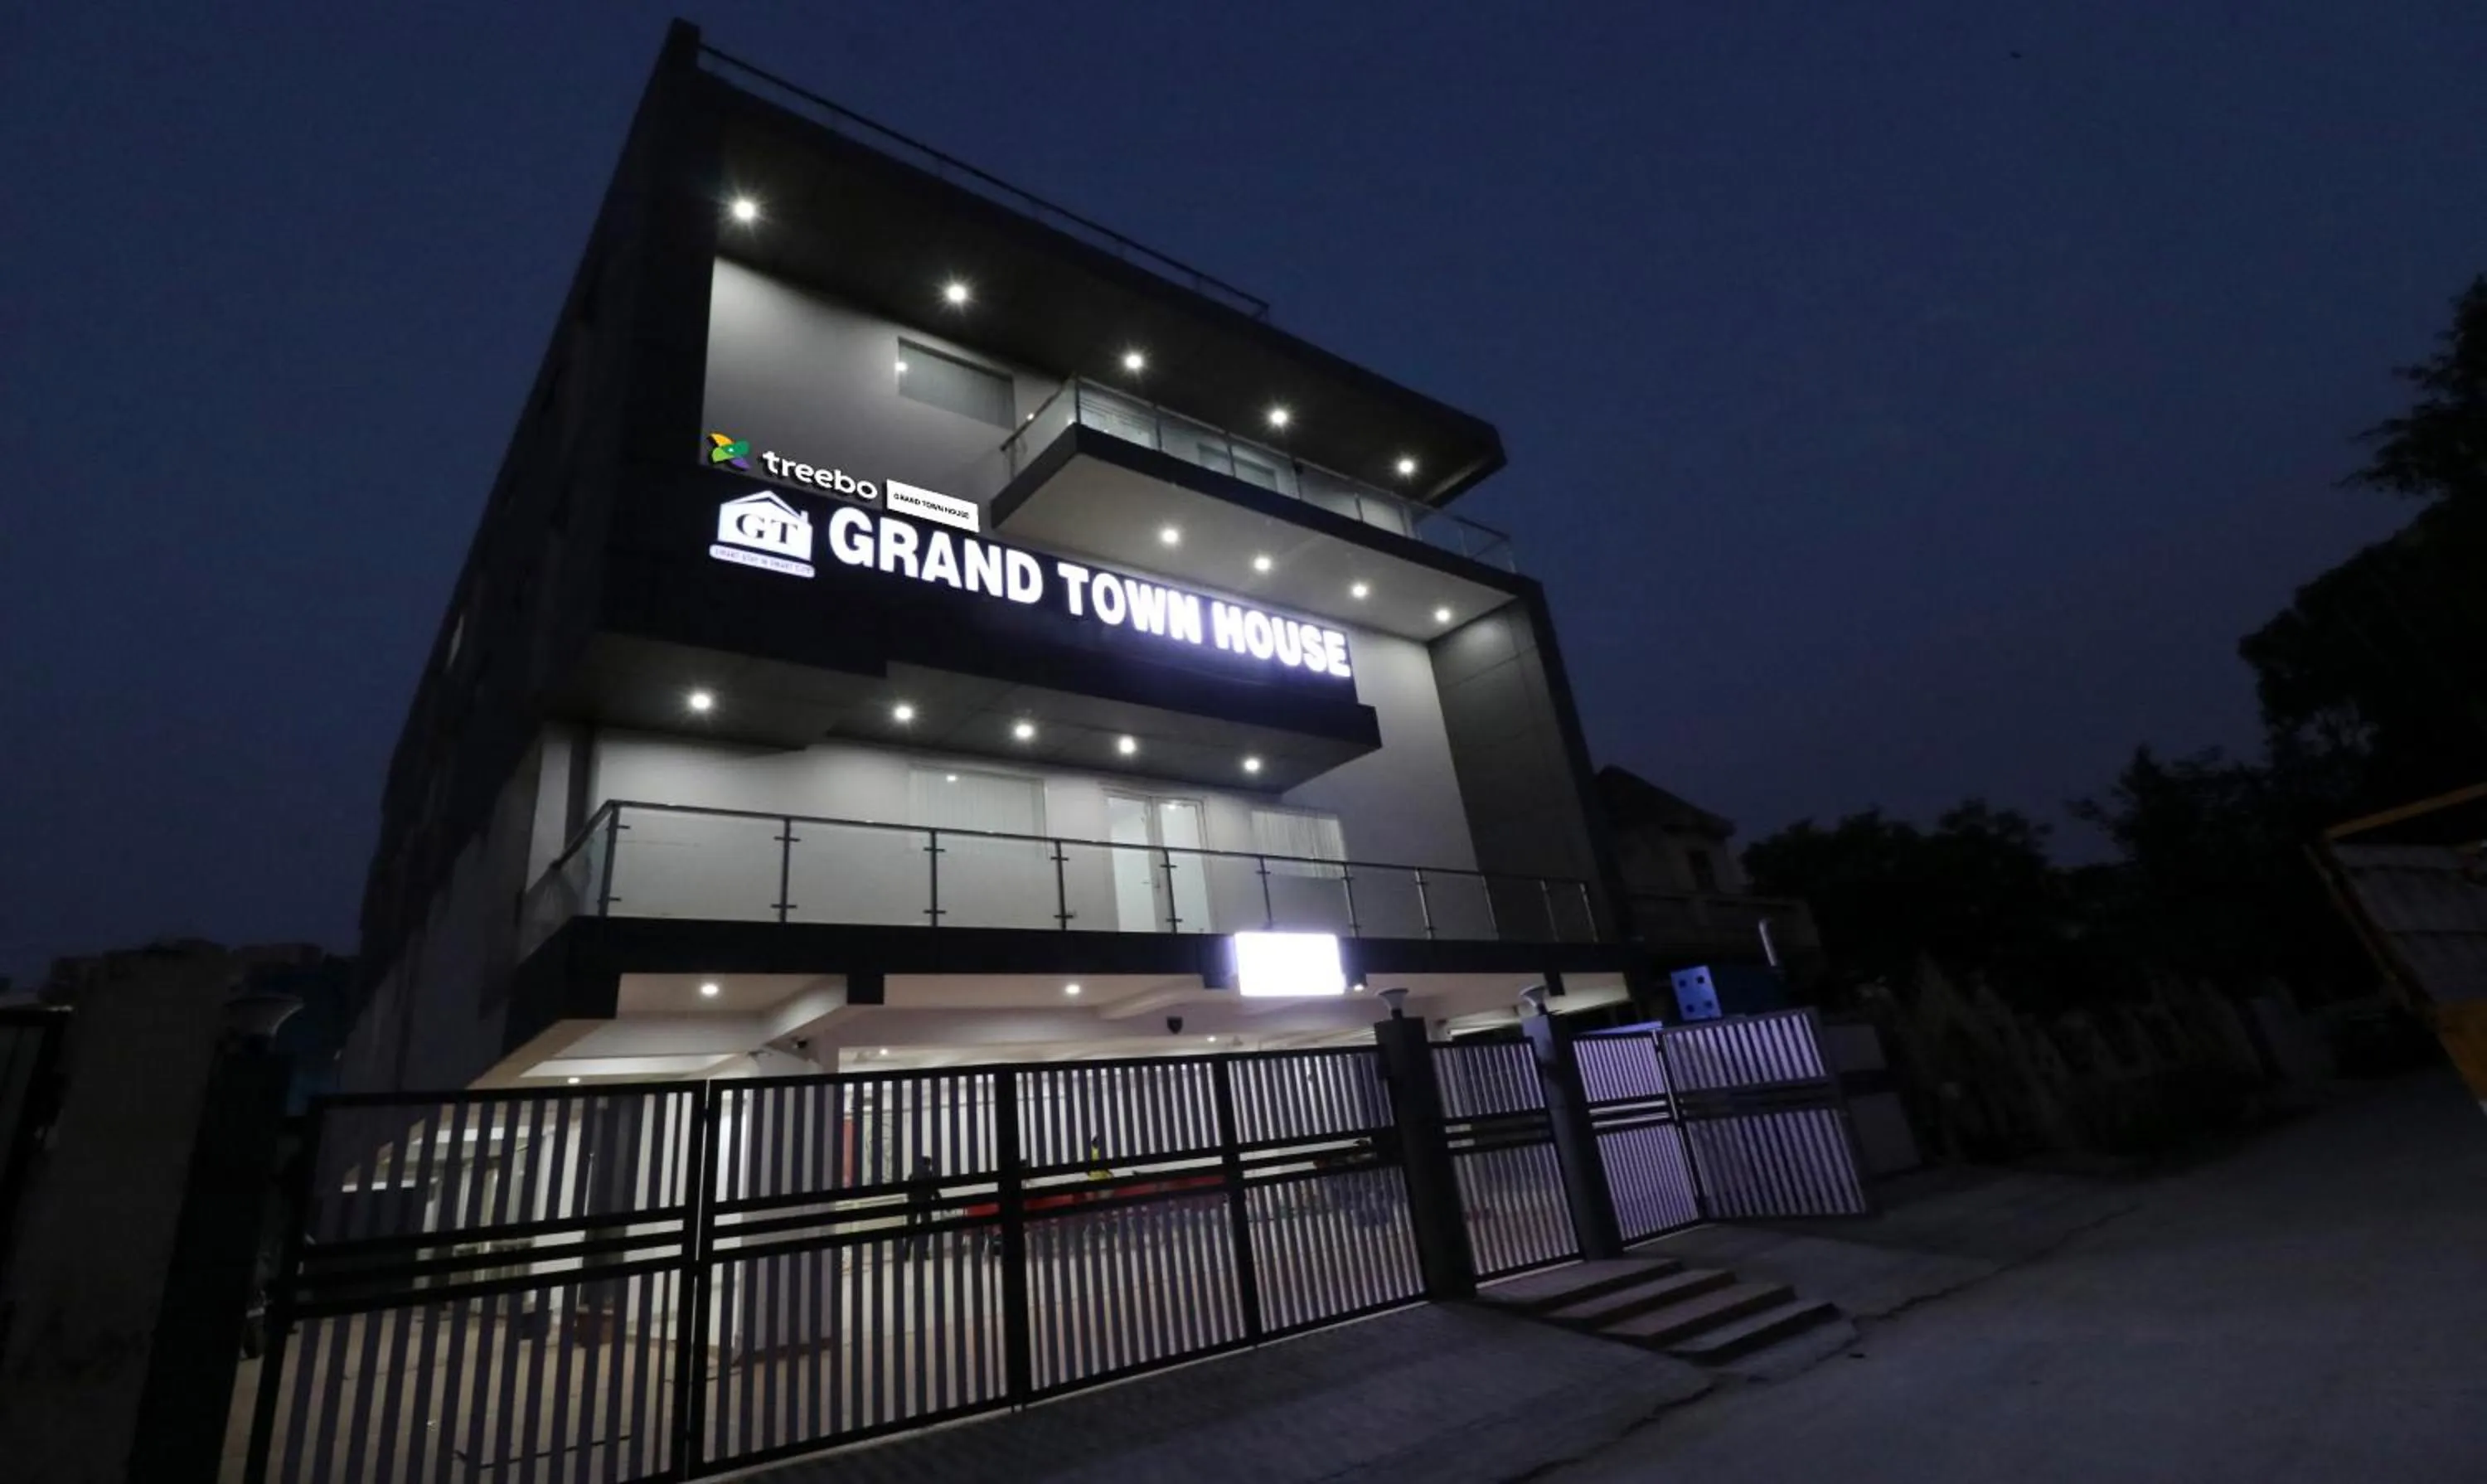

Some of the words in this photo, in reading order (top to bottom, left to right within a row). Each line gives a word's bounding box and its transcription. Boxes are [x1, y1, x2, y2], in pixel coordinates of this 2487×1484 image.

[762, 450, 878, 500] treebo
[893, 492, 921, 505] GRAND
[735, 512, 798, 545] GT
[829, 507, 1043, 604] GRAND
[1058, 562, 1201, 644] TOWN
[1211, 601, 1350, 678] HOUSE
